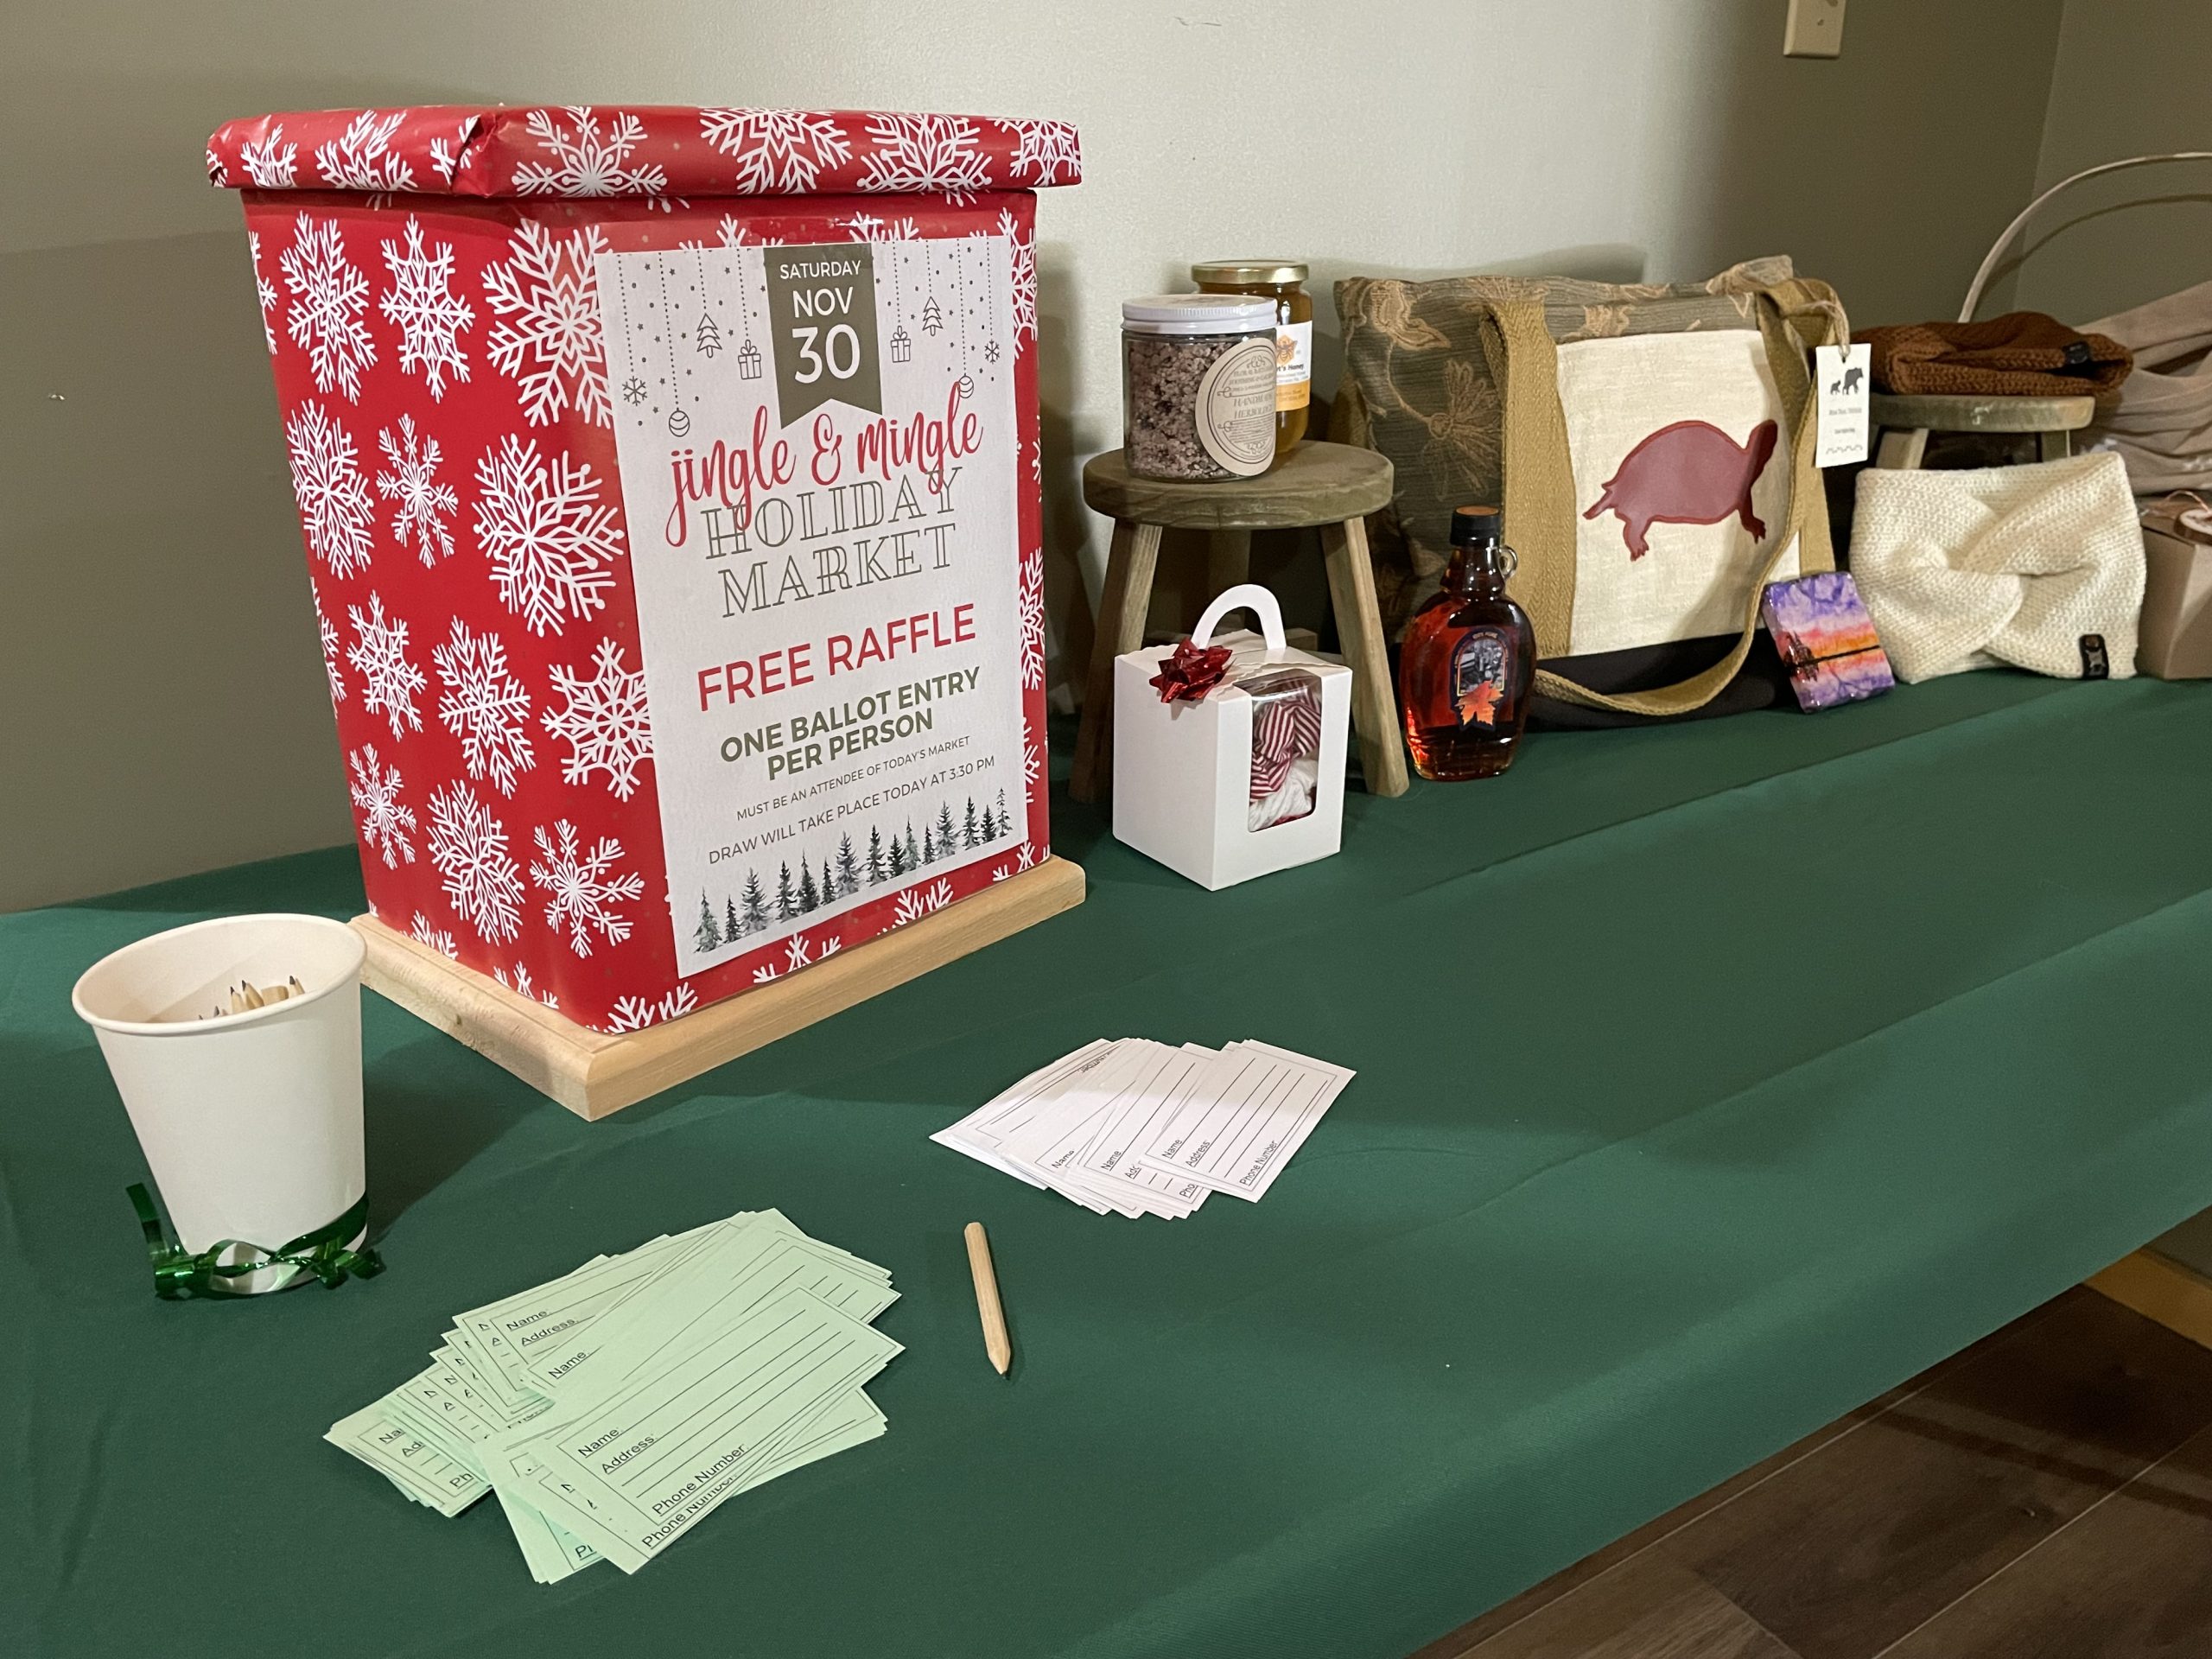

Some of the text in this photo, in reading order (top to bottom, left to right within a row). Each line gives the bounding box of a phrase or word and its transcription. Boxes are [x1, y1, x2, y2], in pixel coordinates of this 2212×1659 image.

[779, 260, 861, 280] SATURDAY
[792, 286, 854, 319] NOV
[791, 324, 861, 384] 30
[665, 381, 984, 548] jingle & mingle
[700, 467, 963, 560] HOLIDAY
[717, 523, 957, 619] MARKET
[697, 603, 976, 712] FREE RAFFLE
[720, 666, 981, 762] ONE BALLOT ENTRY
[767, 708, 933, 781] PER PERSON
[709, 838, 758, 865] DRAW
[760, 824, 796, 849] WILL
[798, 810, 836, 834] TAKE
[837, 792, 881, 819] PLACE
[882, 776, 929, 804] TODAY
[930, 770, 949, 788] AT
[976, 755, 995, 774] PM
[736, 735, 971, 822] MUST BE AN ATTENDEE OF TODAY'S MARKET
[1179, 1183, 1196, 1198] Pho
[1239, 1162, 1261, 1185] Phone
[641, 1513, 686, 1548] Phone
[652, 1482, 696, 1515] Phone
